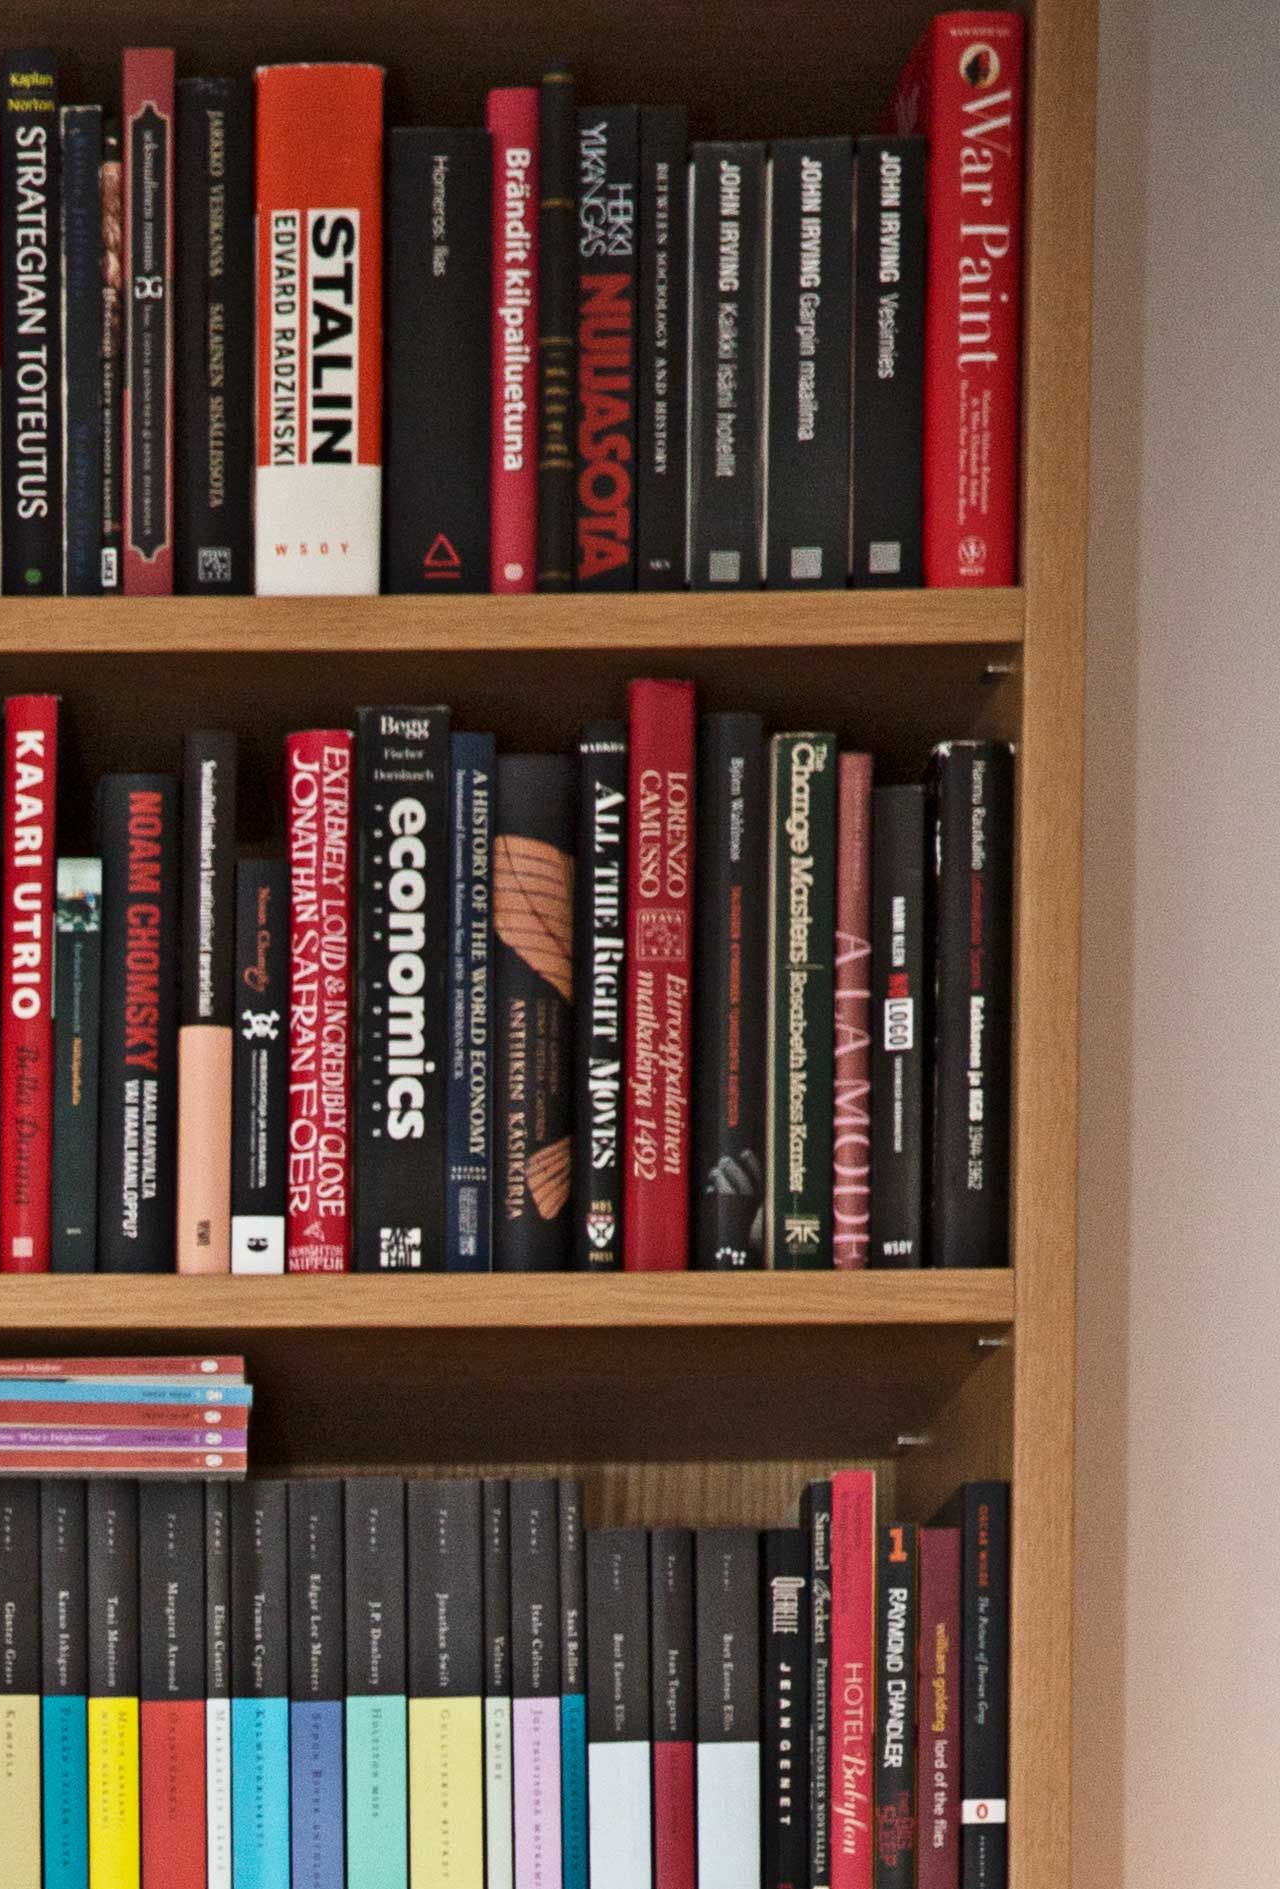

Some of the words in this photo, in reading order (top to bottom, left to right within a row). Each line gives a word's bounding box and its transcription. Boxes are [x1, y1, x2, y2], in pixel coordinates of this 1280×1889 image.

[506, 148, 530, 261] Brändit
[958, 90, 1010, 207] War
[16, 127, 46, 334] STRATEGIAN
[274, 216, 295, 315] EDVARD
[313, 215, 352, 464] STALIN
[958, 220, 1009, 369] Paint
[17, 346, 46, 518] TOTEUTUS
[273, 328, 295, 466] RADZINSKI
[501, 268, 530, 471] kilpailuetuna
[16, 730, 44, 866] KAARI
[129, 791, 161, 892] NOAM
[13, 882, 40, 1020] UTRIO
[126, 903, 160, 1070] CHOMSKY
[385, 797, 435, 1140] economics
[887, 1588, 907, 1672] RAYMOND
[884, 1680, 908, 1768] CHANDLER
[934, 1740, 946, 1768] lord
[934, 1772, 947, 1788] of
[934, 1792, 947, 1815] the
[934, 1819, 947, 1847] flies
